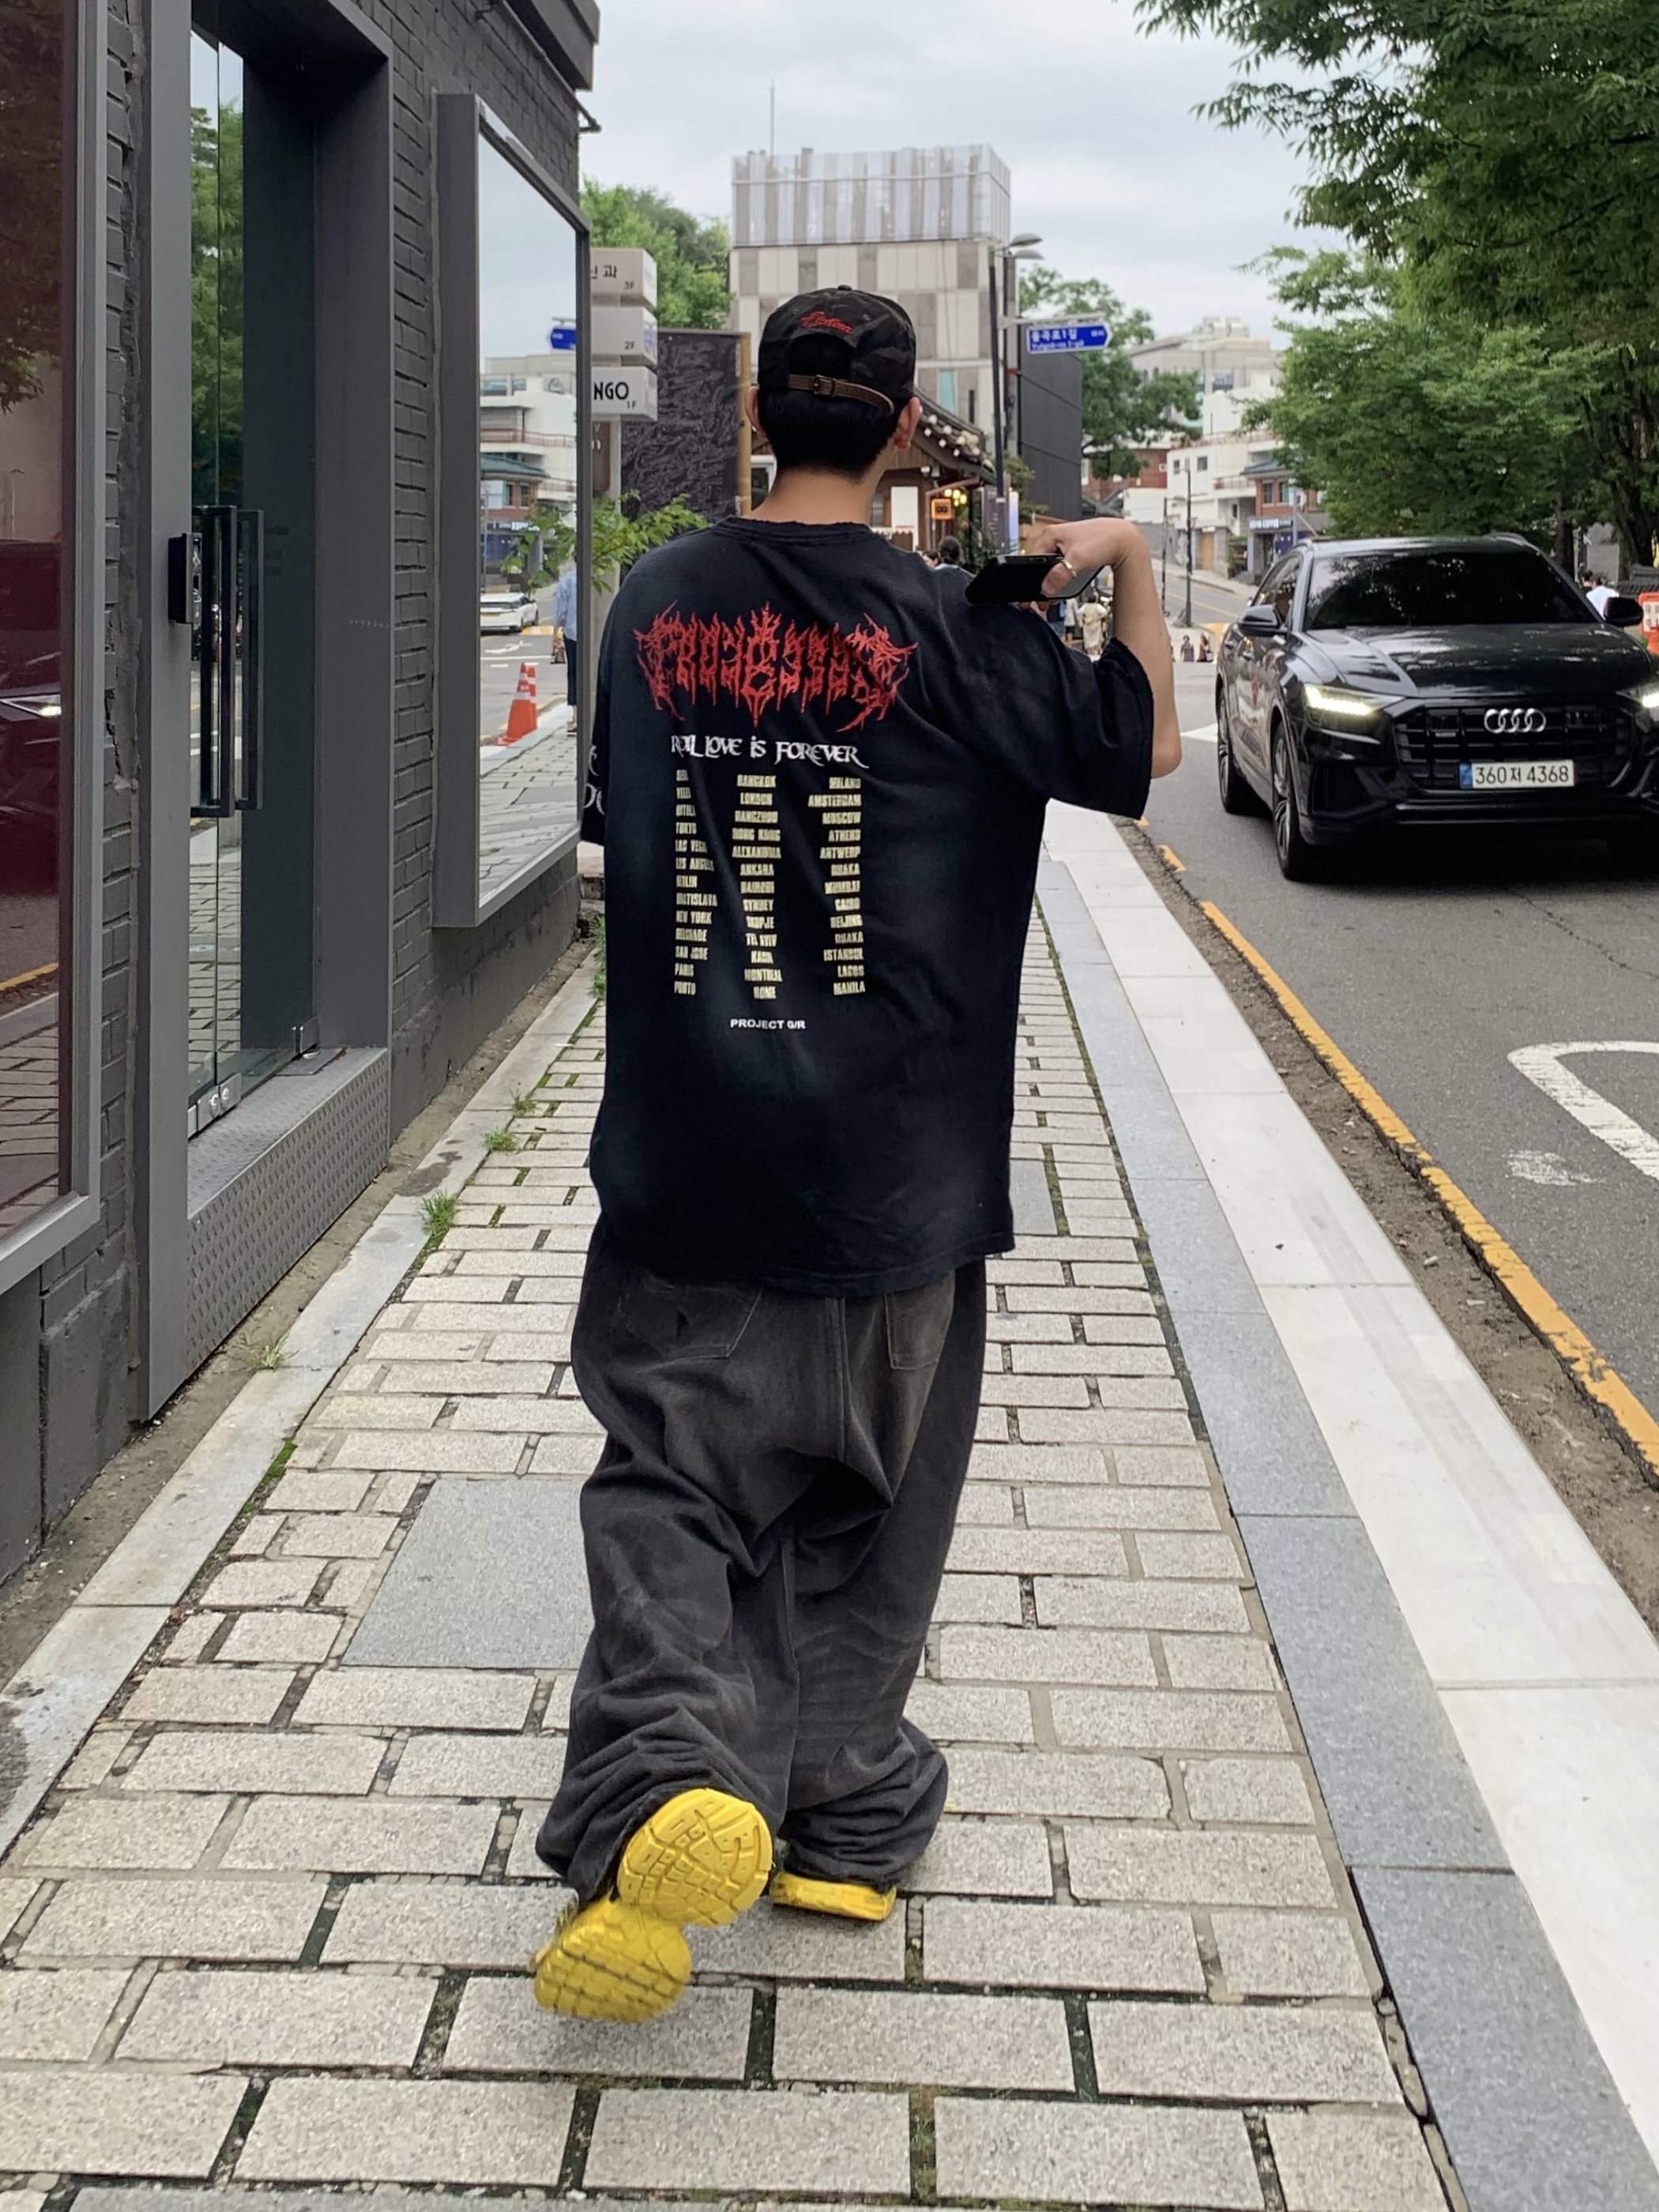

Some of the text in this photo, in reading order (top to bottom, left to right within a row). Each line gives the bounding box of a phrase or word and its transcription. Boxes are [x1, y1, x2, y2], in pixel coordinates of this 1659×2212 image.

[624, 281, 635, 290] 3F
[624, 341, 635, 350] 2F
[626, 401, 637, 409] 1F
[705, 735, 743, 758] LOVE
[773, 740, 871, 769] FOREVER
[1527, 765, 1569, 783] 4368
[838, 965, 863, 977] LAGOS
[754, 986, 776, 999] ROME
[833, 981, 865, 995] MANILA
[730, 1018, 785, 1030] PROJECT
